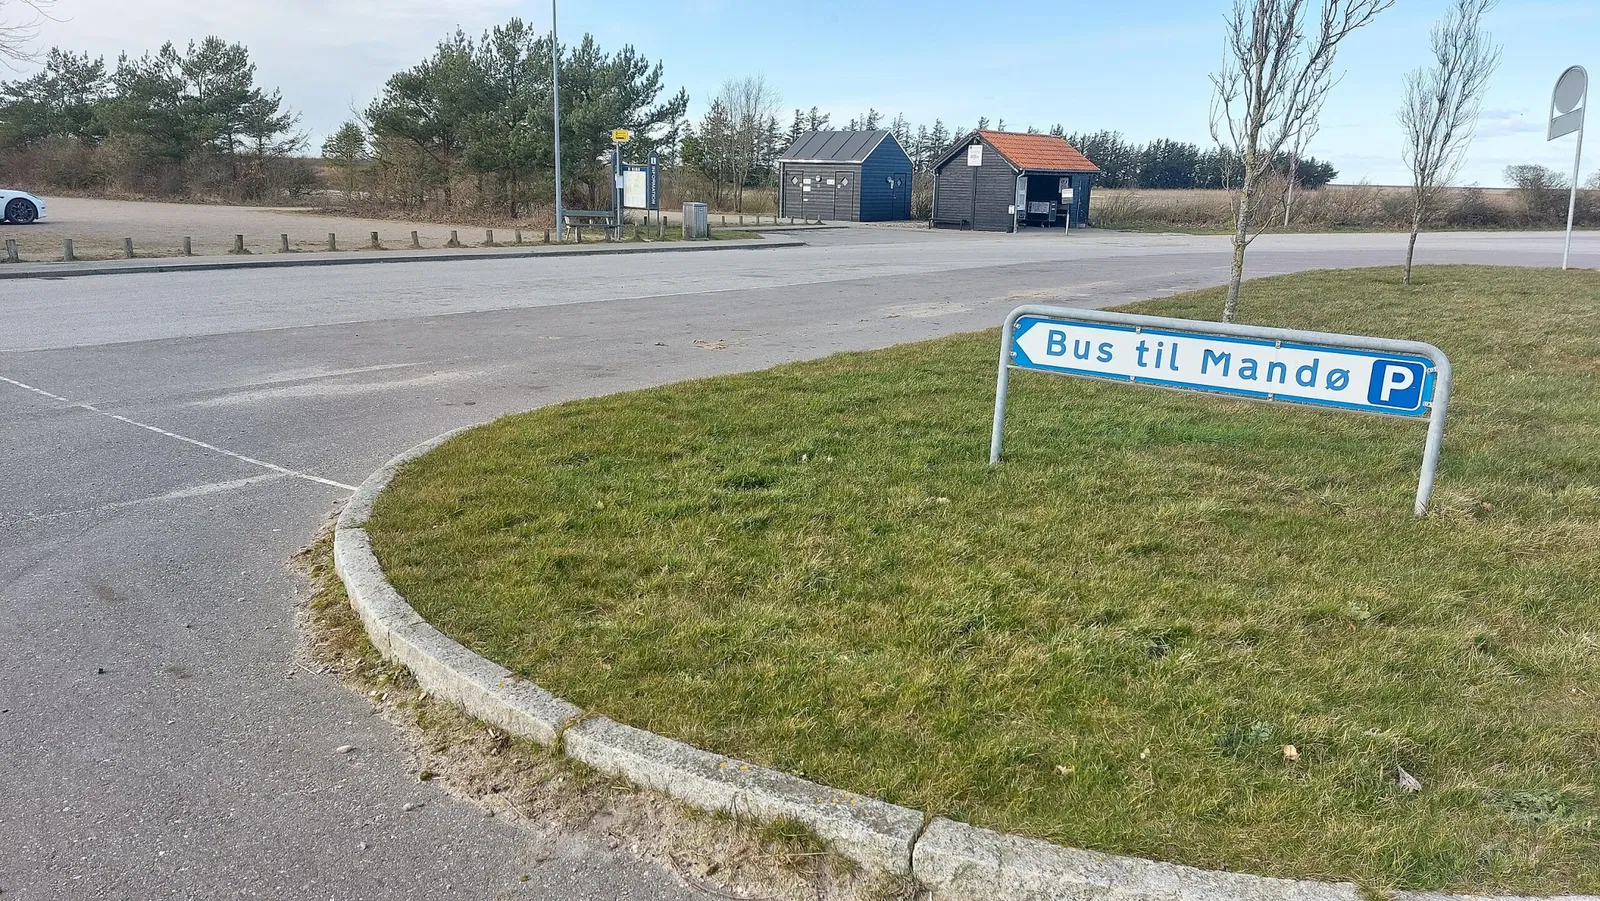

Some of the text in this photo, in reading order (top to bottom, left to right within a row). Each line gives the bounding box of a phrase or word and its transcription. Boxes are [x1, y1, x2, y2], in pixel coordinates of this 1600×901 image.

[1046, 330, 1416, 402] Bus til Mandø P
